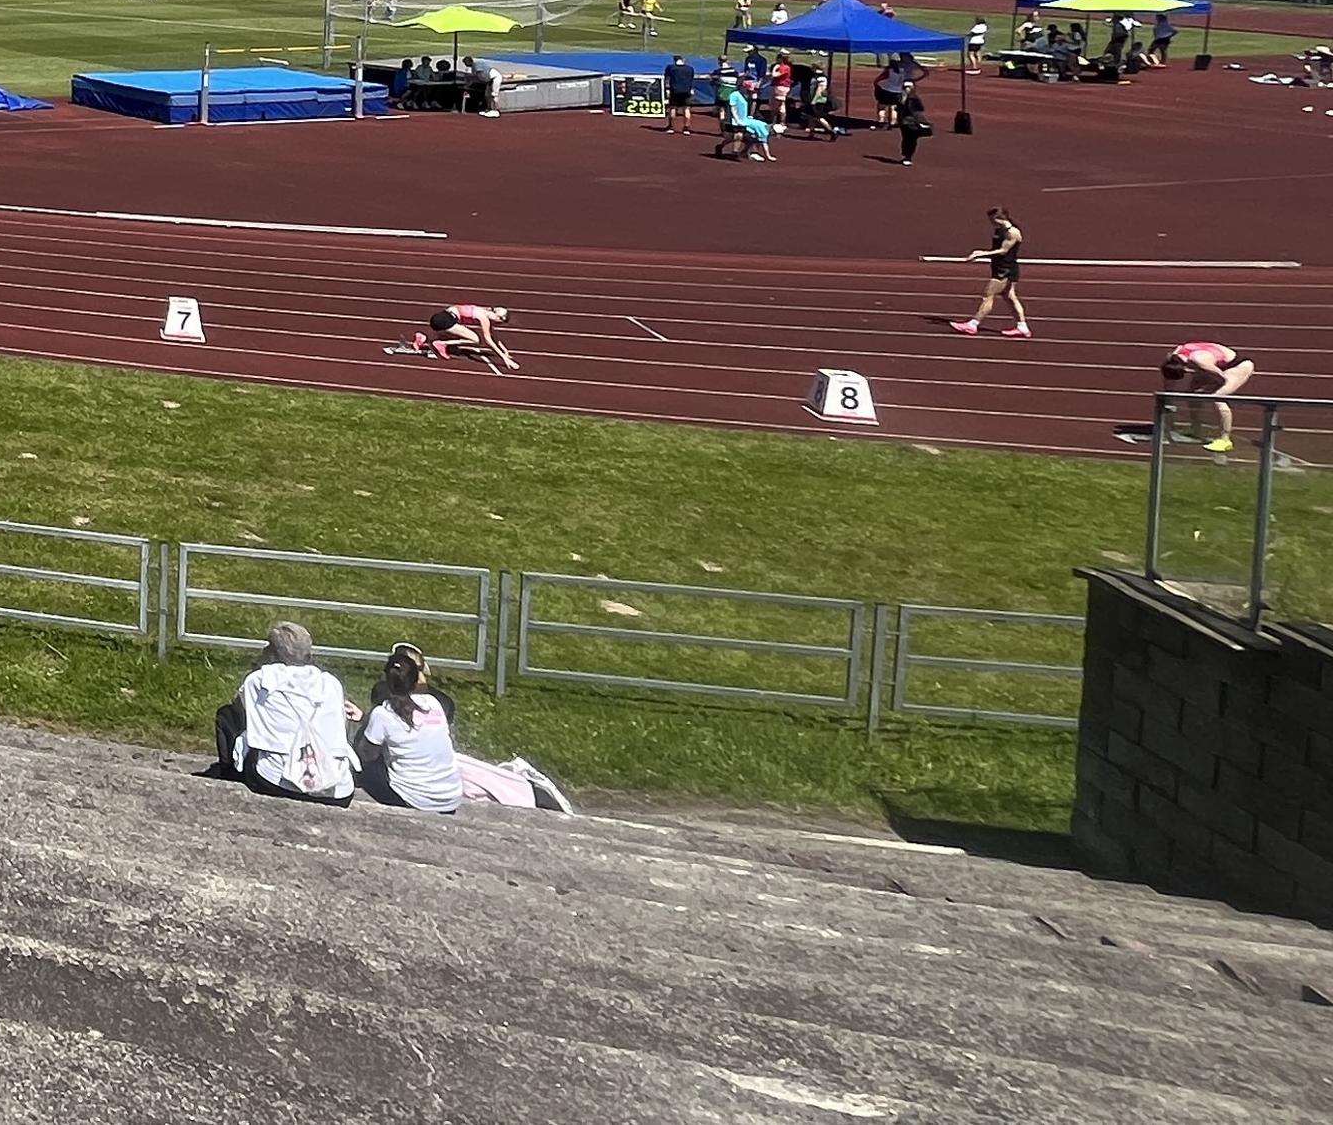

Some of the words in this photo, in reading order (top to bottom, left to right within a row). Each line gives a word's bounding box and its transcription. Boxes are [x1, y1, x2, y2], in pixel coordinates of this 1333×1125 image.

[627, 99, 662, 113] 200
[177, 310, 191, 330] 7
[841, 387, 859, 410] 8
